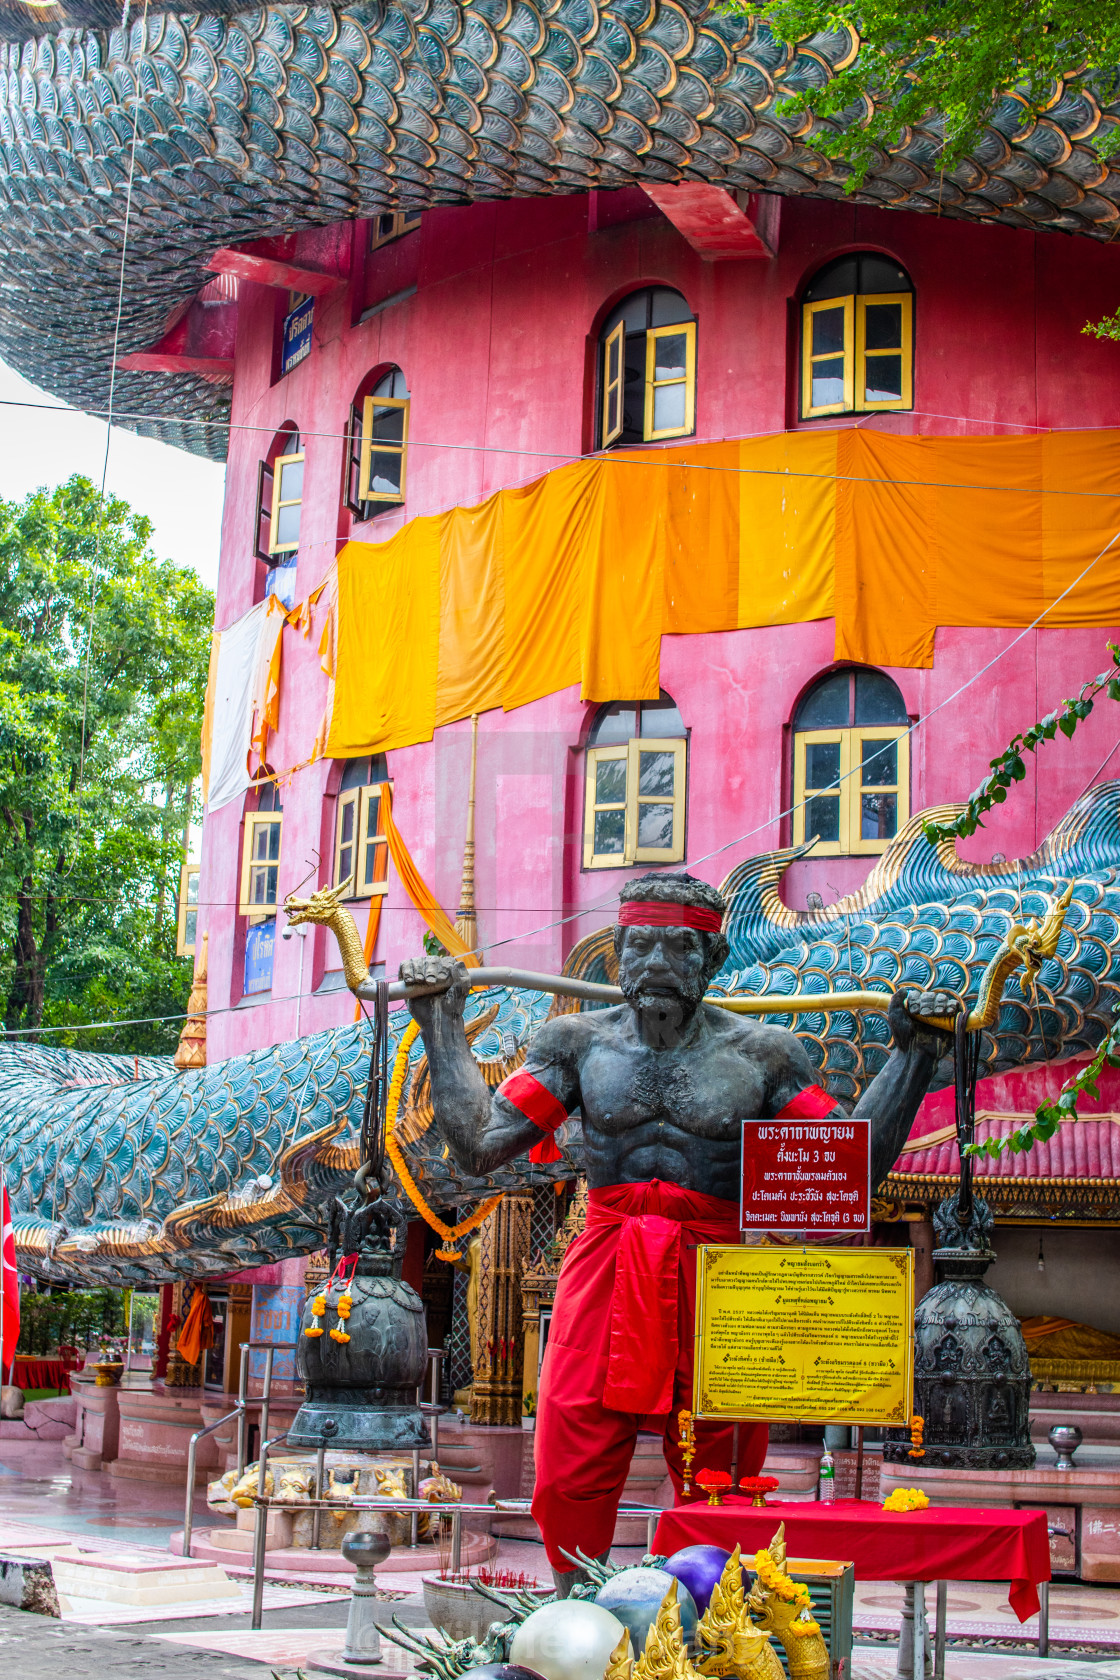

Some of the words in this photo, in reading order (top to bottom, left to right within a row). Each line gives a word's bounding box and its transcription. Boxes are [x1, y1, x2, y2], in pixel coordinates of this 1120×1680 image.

[758, 1126, 854, 1144] พระคาถาพญายม
[777, 1142, 809, 1162] ตั้งนะโม
[813, 1150, 819, 1162] 3
[824, 1151, 835, 1162] จบ
